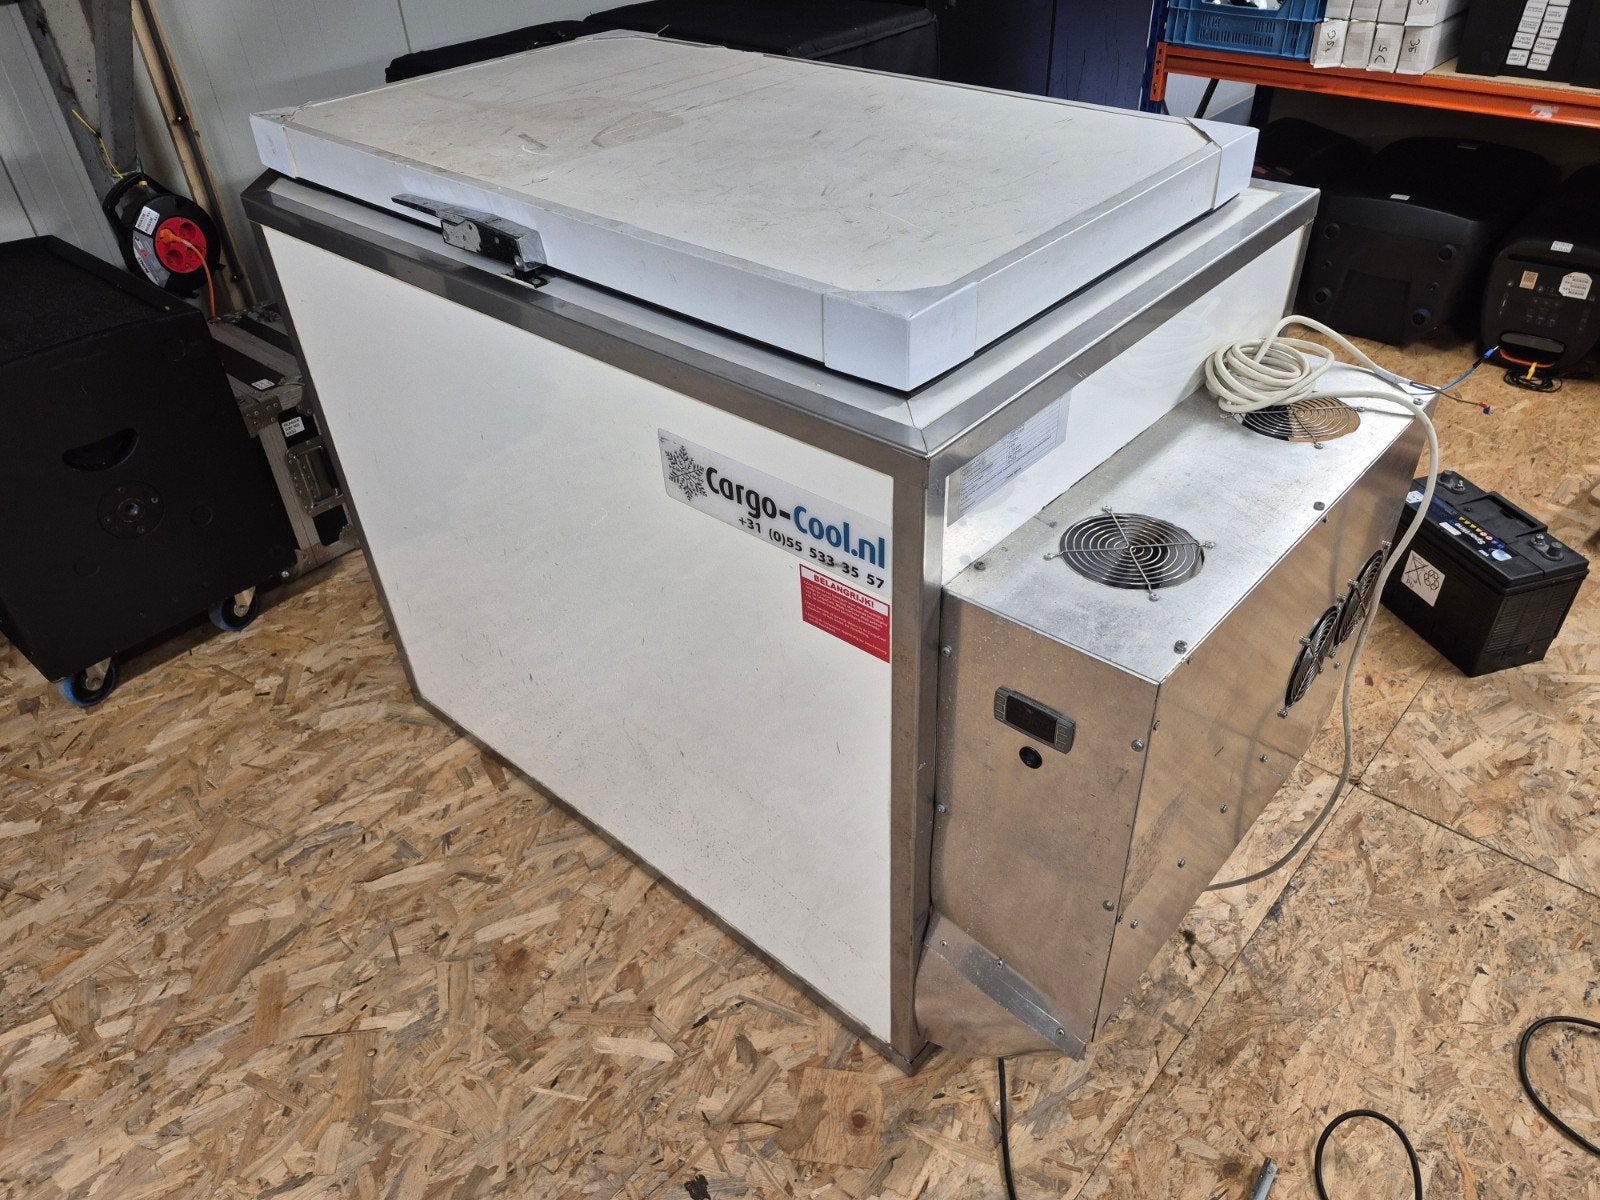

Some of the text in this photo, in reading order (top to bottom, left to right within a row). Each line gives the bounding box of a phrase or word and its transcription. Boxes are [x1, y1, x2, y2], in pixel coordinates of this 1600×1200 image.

[706, 467, 885, 569] Cargo-Cool.nl
[738, 516, 885, 589] +31 (0)55 533 35 57
[813, 574, 875, 609] BELANGRIJK!
